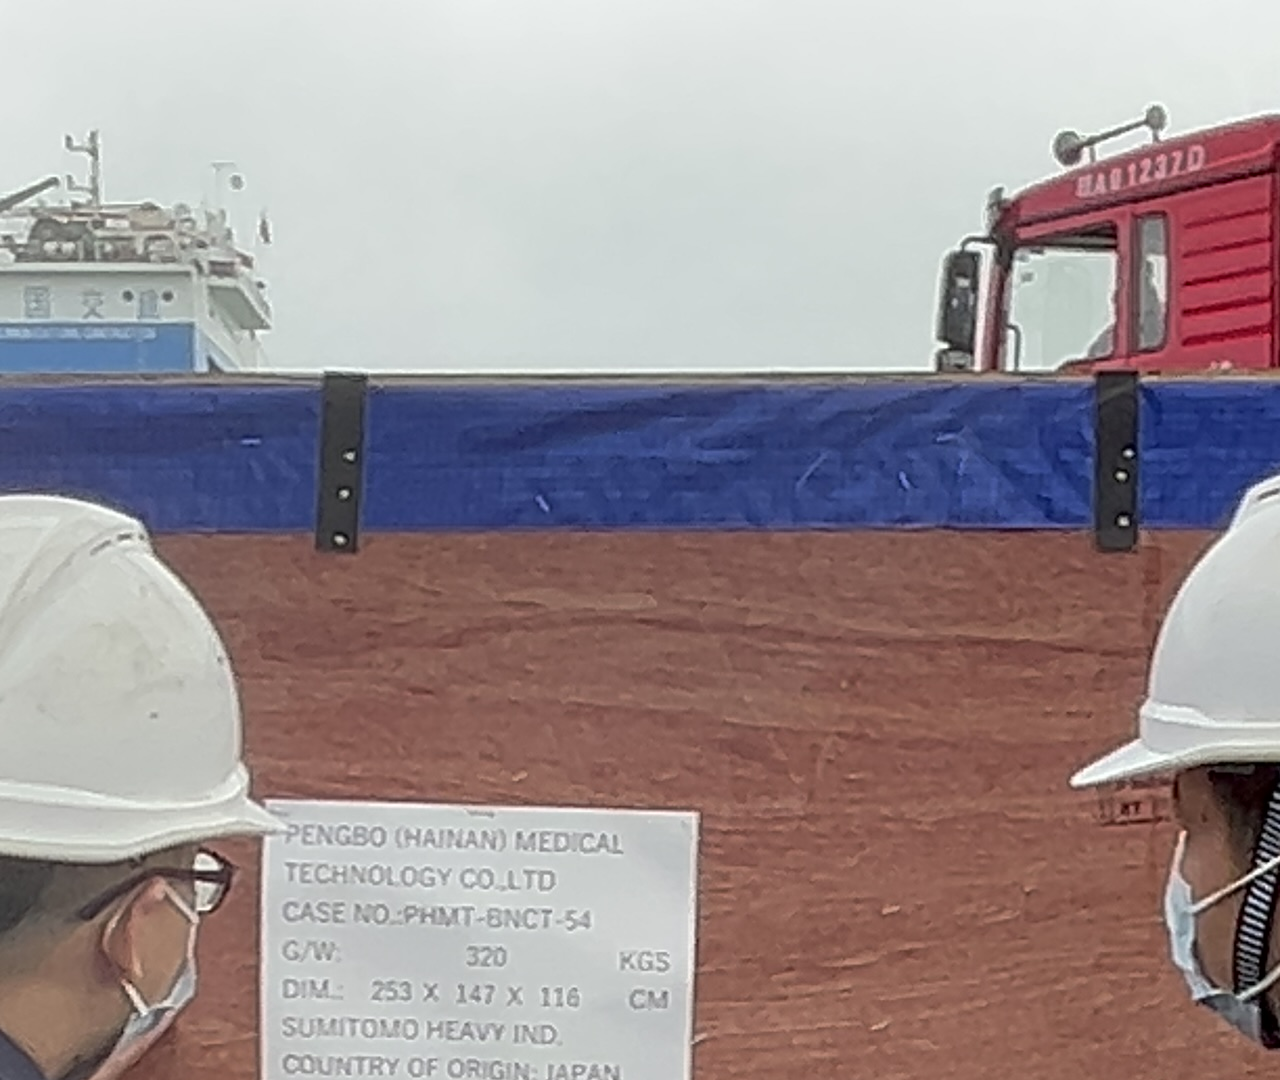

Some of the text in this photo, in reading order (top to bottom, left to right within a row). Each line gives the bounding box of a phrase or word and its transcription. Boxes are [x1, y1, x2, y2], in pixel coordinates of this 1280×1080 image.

[285, 823, 624, 855] PENGBO (HAINAN) MEDICAL
[285, 861, 452, 888] TECHNOLOGY
[282, 900, 346, 924] CASE
[466, 945, 507, 968] 320
[619, 951, 671, 972] KGS
[371, 980, 412, 1001] 253
[423, 982, 439, 1003] X
[456, 983, 496, 1005] 147
[506, 986, 523, 1007] X
[541, 986, 581, 1008] 116
[628, 988, 669, 1010] CM
[282, 1016, 563, 1047] SUMITOMO HEAVY IND.
[282, 1053, 400, 1077] COUNTRY
[407, 1057, 439, 1079] OF
